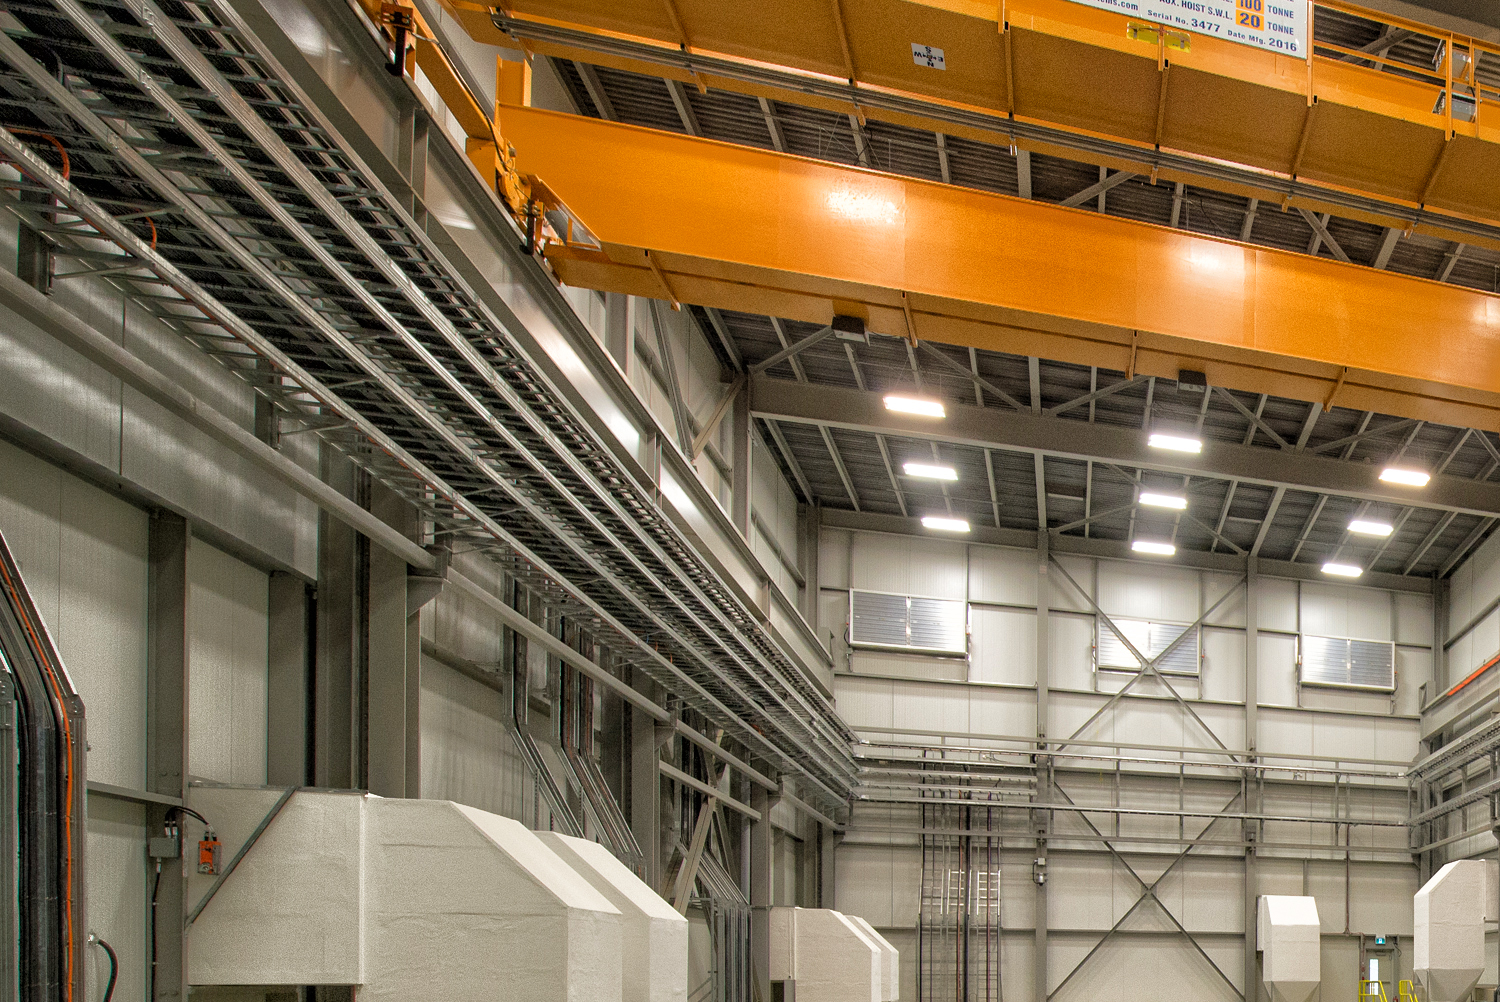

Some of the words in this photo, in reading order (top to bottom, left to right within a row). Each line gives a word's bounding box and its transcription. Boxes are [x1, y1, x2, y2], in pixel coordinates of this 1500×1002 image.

[1181, 0, 1206, 13] HOIST
[1207, 6, 1233, 20] S.W.L.
[1240, 12, 1261, 28] 20
[1267, 21, 1295, 36] TONNE
[1267, 4, 1295, 19] TONNE
[1147, 9, 1173, 21] Serial
[1175, 16, 1189, 25] No.
[1191, 17, 1221, 33] 3477
[1227, 29, 1246, 40] Date
[1248, 34, 1266, 45] Mfg.
[1268, 37, 1297, 52] 2016
